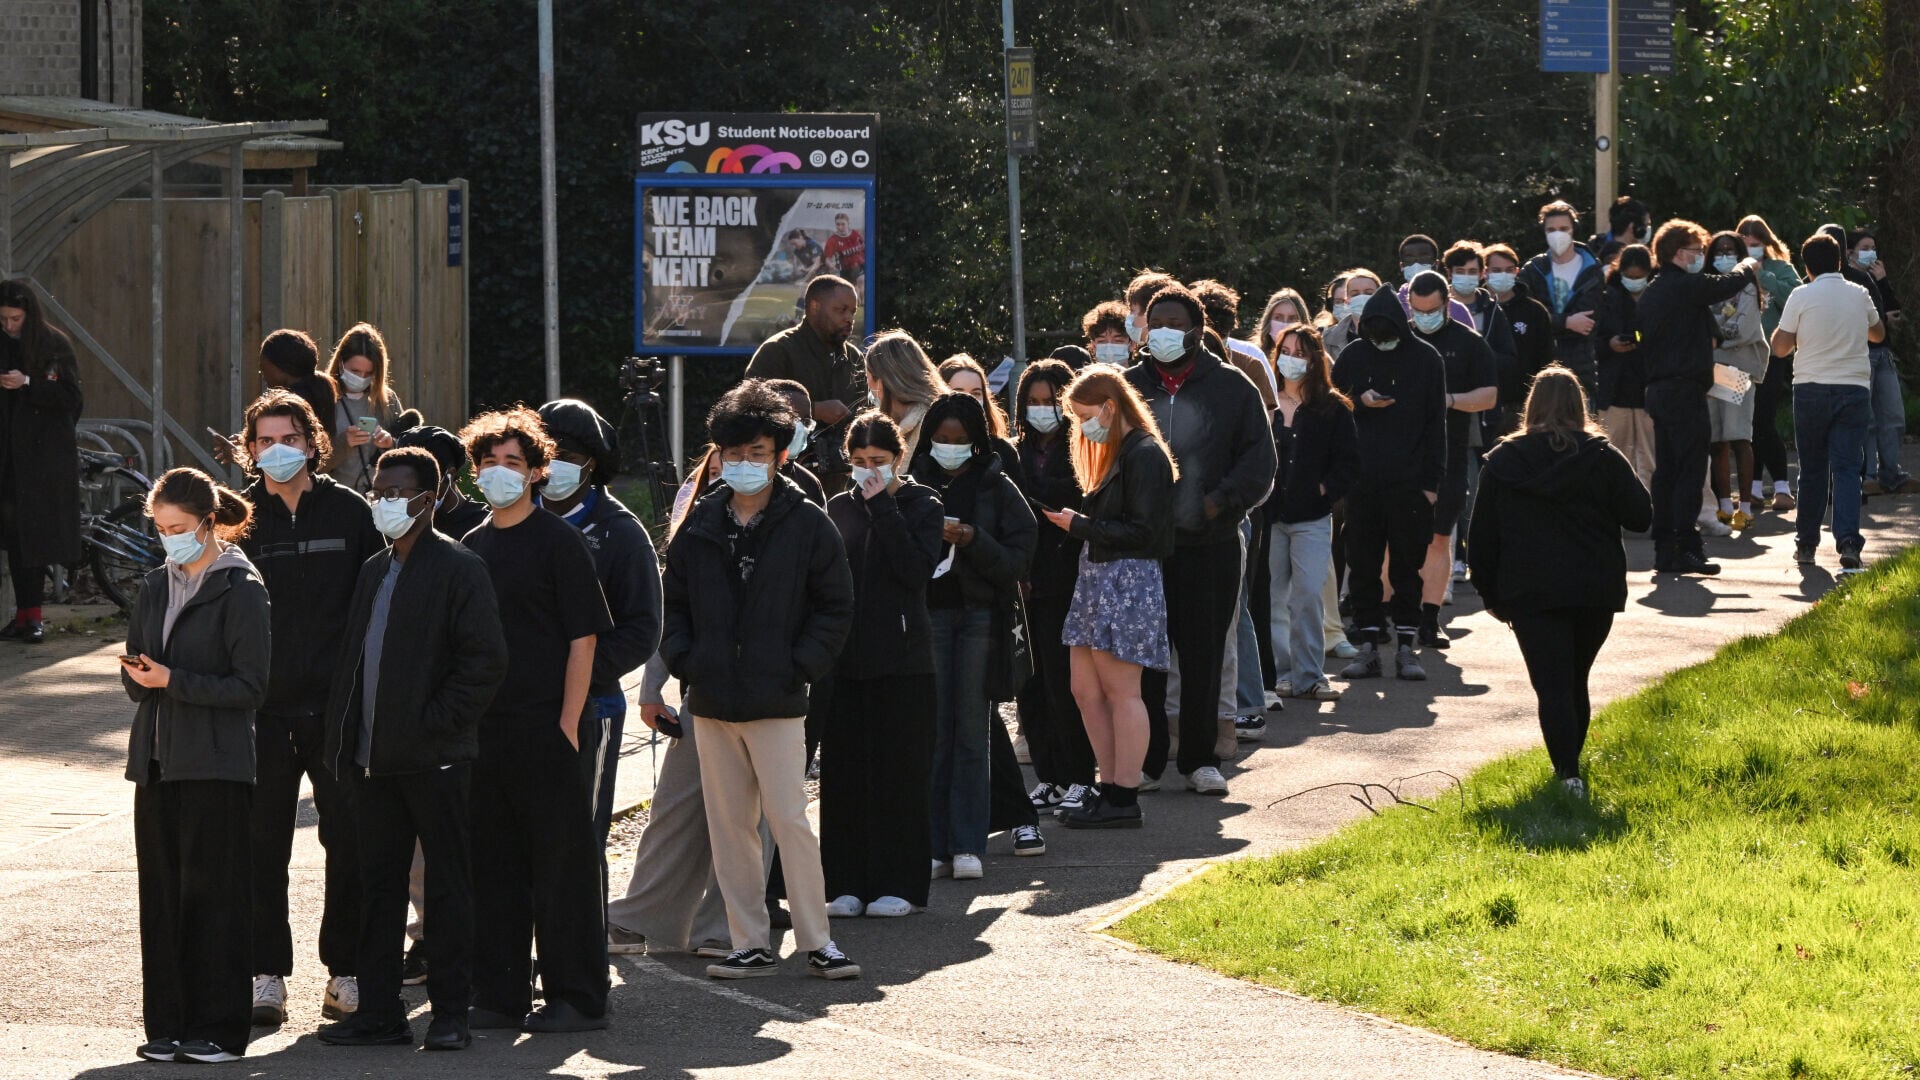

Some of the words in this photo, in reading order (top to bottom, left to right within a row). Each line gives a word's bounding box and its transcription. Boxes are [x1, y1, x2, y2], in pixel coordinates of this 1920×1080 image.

[1011, 67, 1030, 89] 24/7
[641, 119, 710, 146] KSU
[717, 126, 776, 138] Student
[779, 126, 870, 139] Noticeboard
[641, 145, 665, 156] KENT
[641, 157, 667, 166] UNION
[652, 196, 690, 226] WE
[695, 196, 758, 226] BACK
[652, 227, 717, 256] TEAM
[652, 257, 712, 287] KENT
